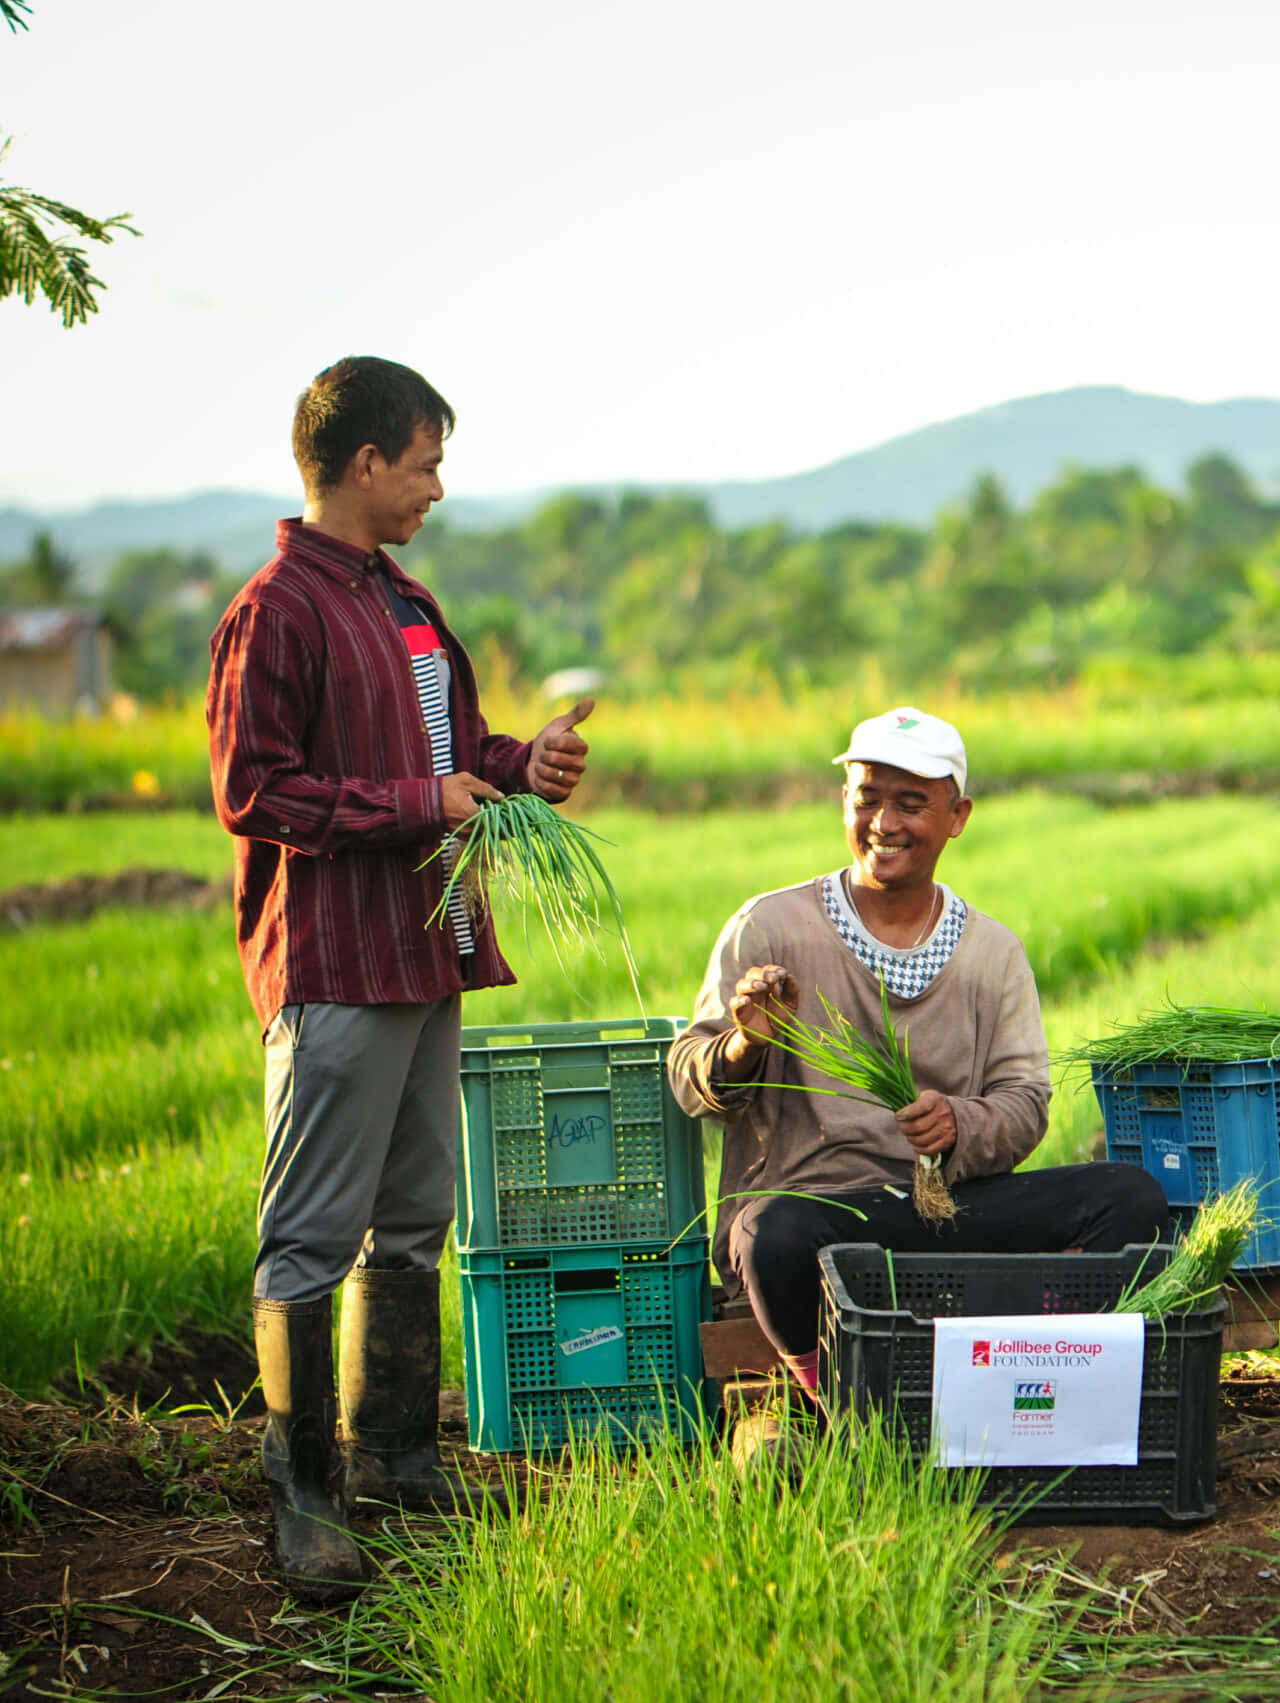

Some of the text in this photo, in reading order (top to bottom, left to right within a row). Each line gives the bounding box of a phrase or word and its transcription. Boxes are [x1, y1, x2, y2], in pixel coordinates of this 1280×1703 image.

[993, 1340, 1103, 1357] Jollibee Group
[993, 1355, 1091, 1367] FOUNDATION
[1012, 1411, 1054, 1422] Farmer
